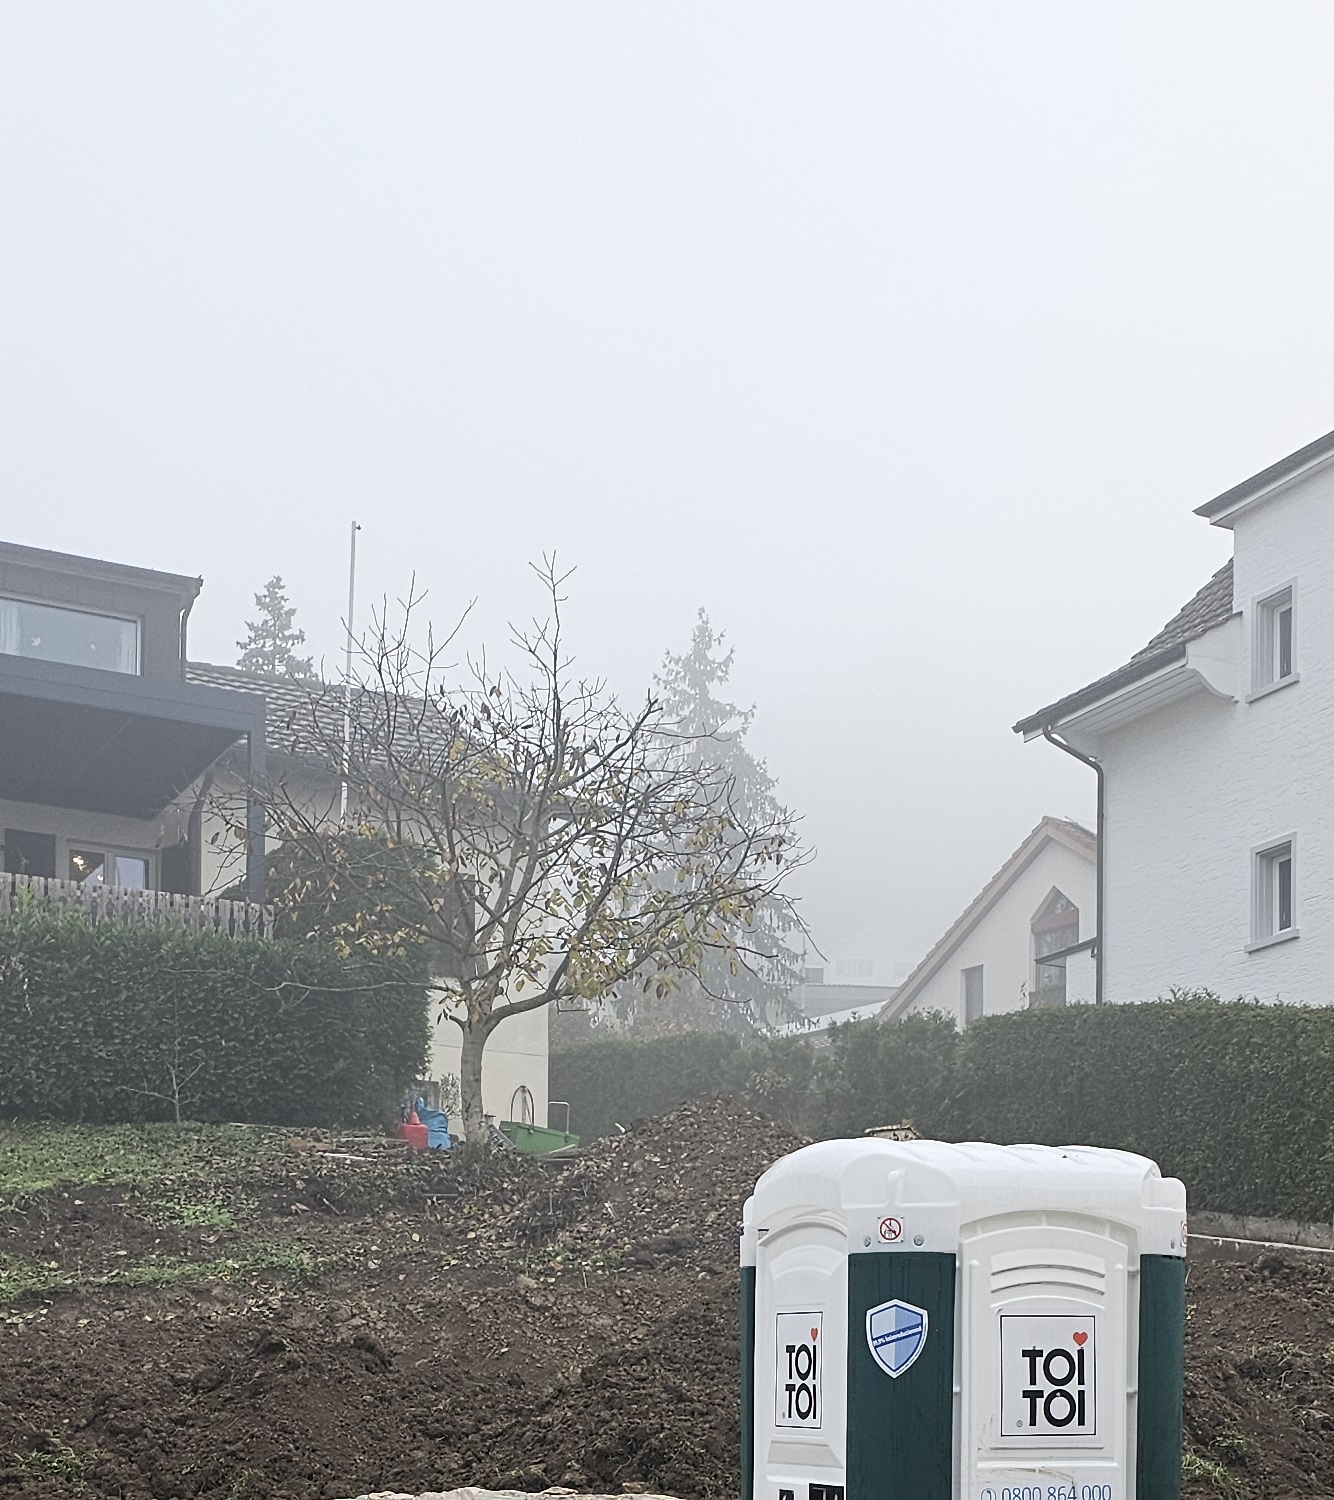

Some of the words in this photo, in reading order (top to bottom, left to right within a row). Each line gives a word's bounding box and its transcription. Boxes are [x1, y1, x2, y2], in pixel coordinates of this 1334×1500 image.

[785, 1344, 817, 1381] TOI
[1021, 1347, 1086, 1387] TOI
[785, 1383, 817, 1420] TOI
[1021, 1388, 1086, 1428] TOI
